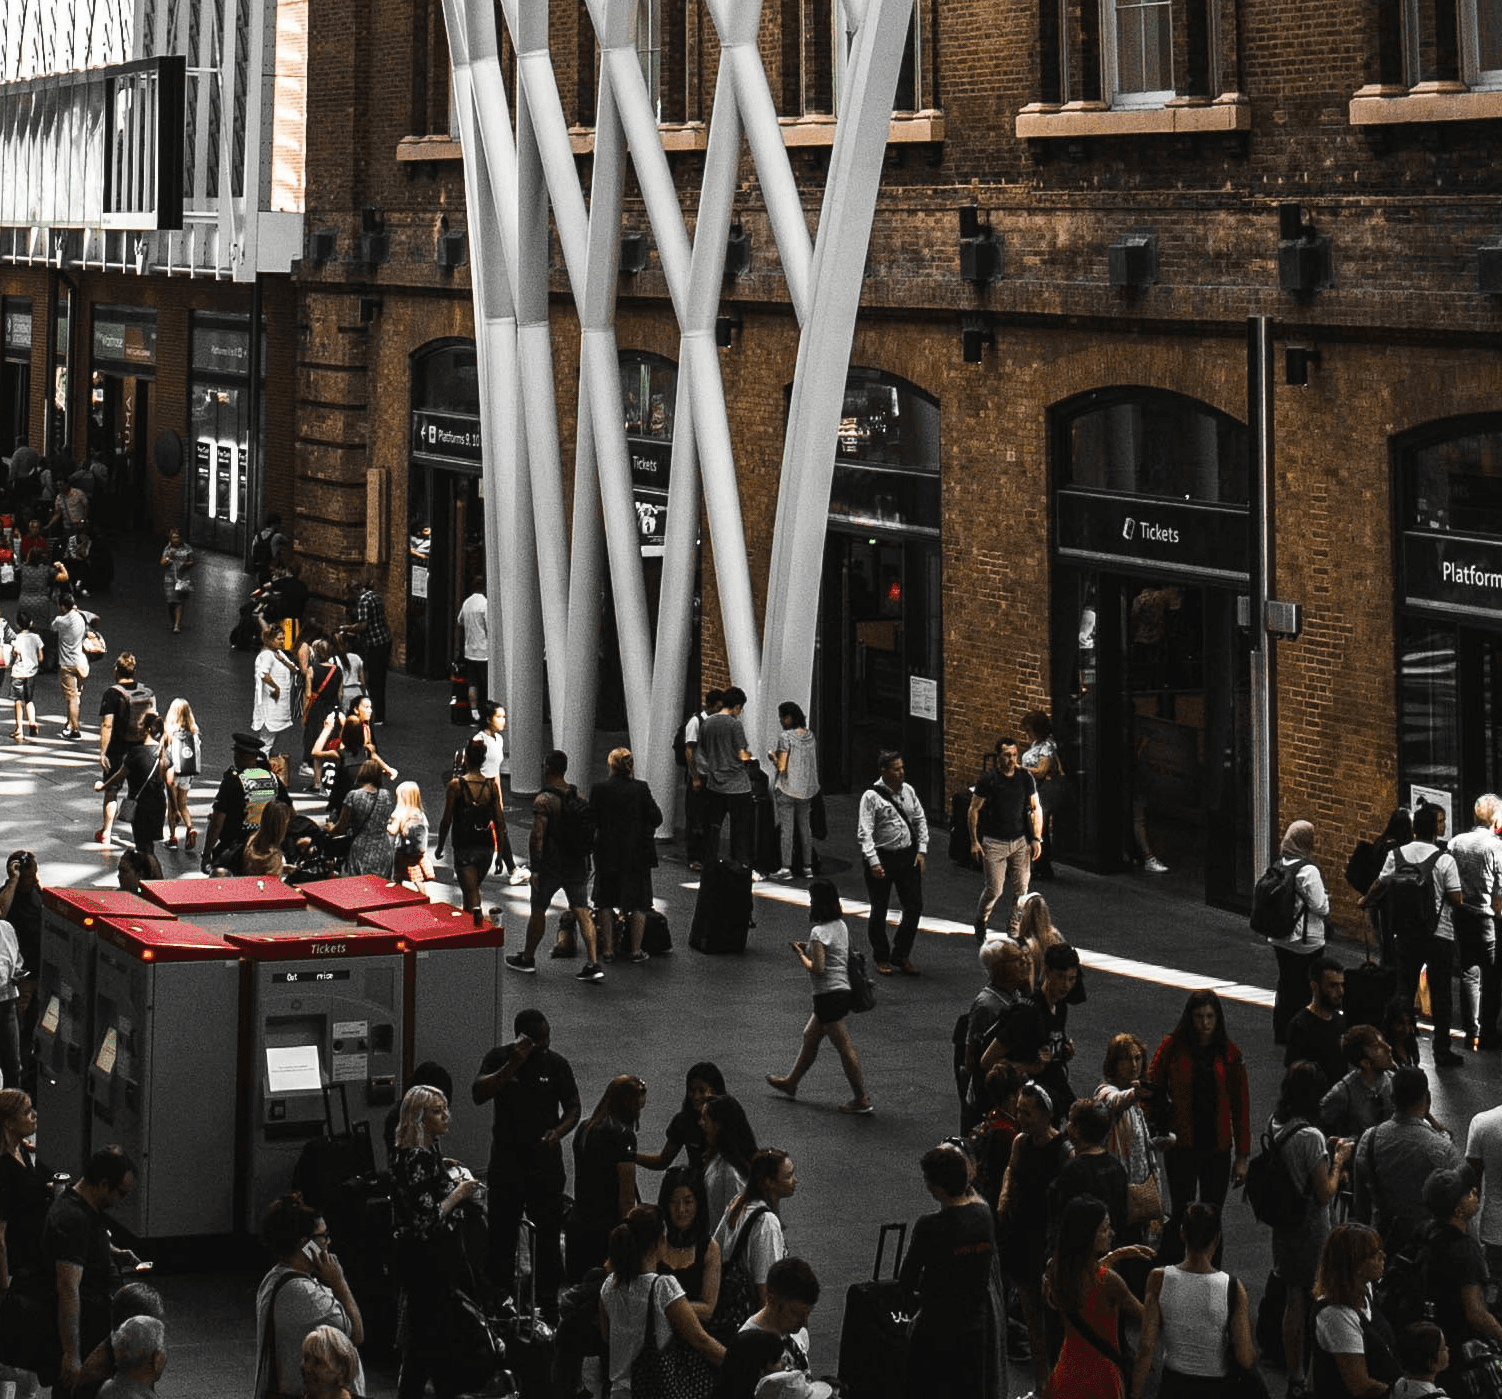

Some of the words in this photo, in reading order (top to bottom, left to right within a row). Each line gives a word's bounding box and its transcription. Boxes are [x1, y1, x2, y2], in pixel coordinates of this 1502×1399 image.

[438, 429, 465, 445] Platforms
[633, 455, 657, 472] Tickets
[1139, 521, 1179, 543] Tickets
[311, 943, 347, 955] Tickets
